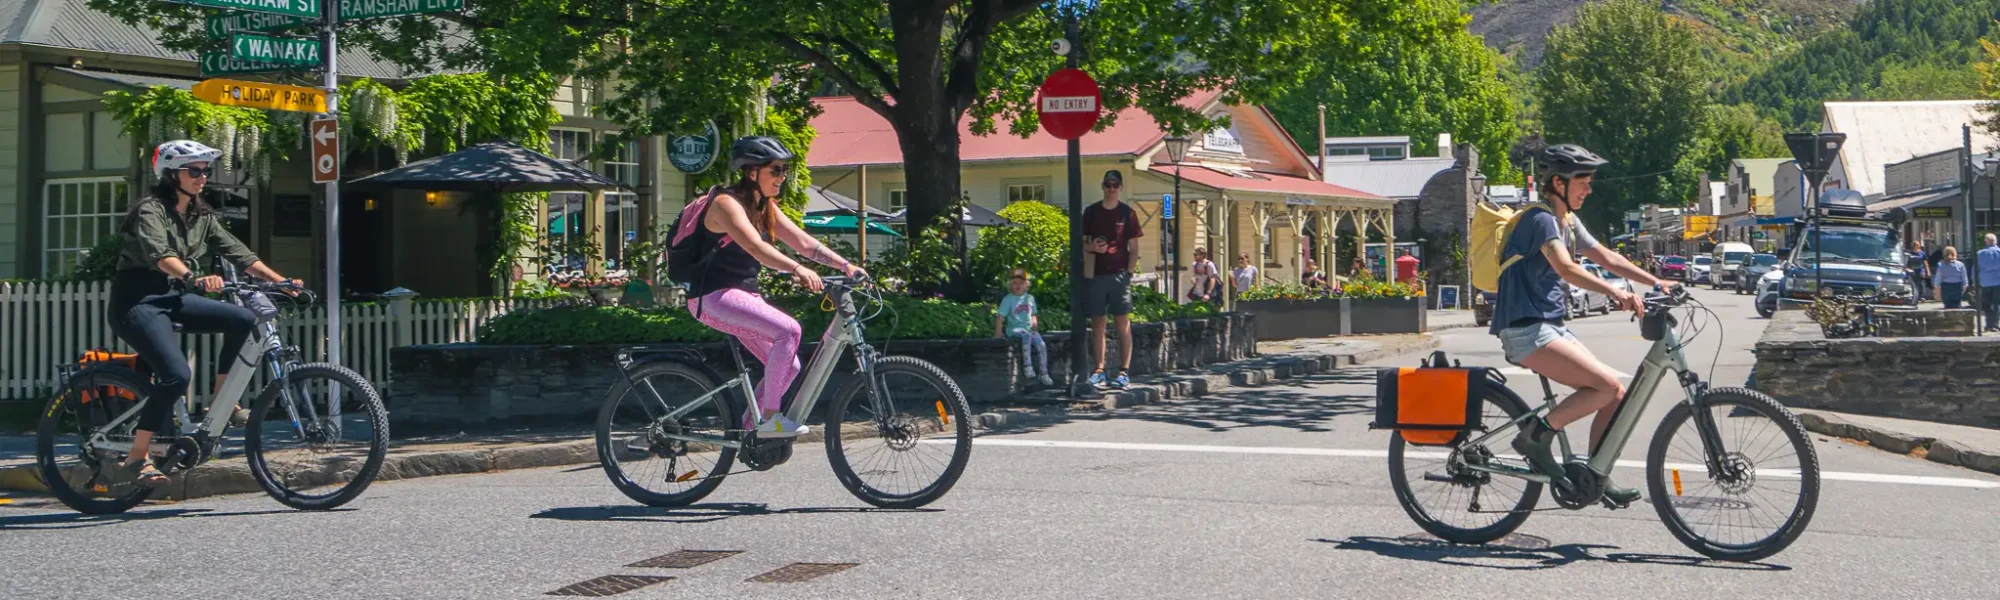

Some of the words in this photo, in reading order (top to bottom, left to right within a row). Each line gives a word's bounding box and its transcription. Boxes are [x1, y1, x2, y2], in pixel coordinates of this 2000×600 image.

[340, 0, 420, 17] RAMSHAW
[249, 38, 320, 61] WANAKA
[222, 84, 277, 103] HOLIDAY
[284, 90, 316, 106] PARK
[1049, 99, 1059, 110] NO
[1064, 98, 1088, 110] ENTRY
